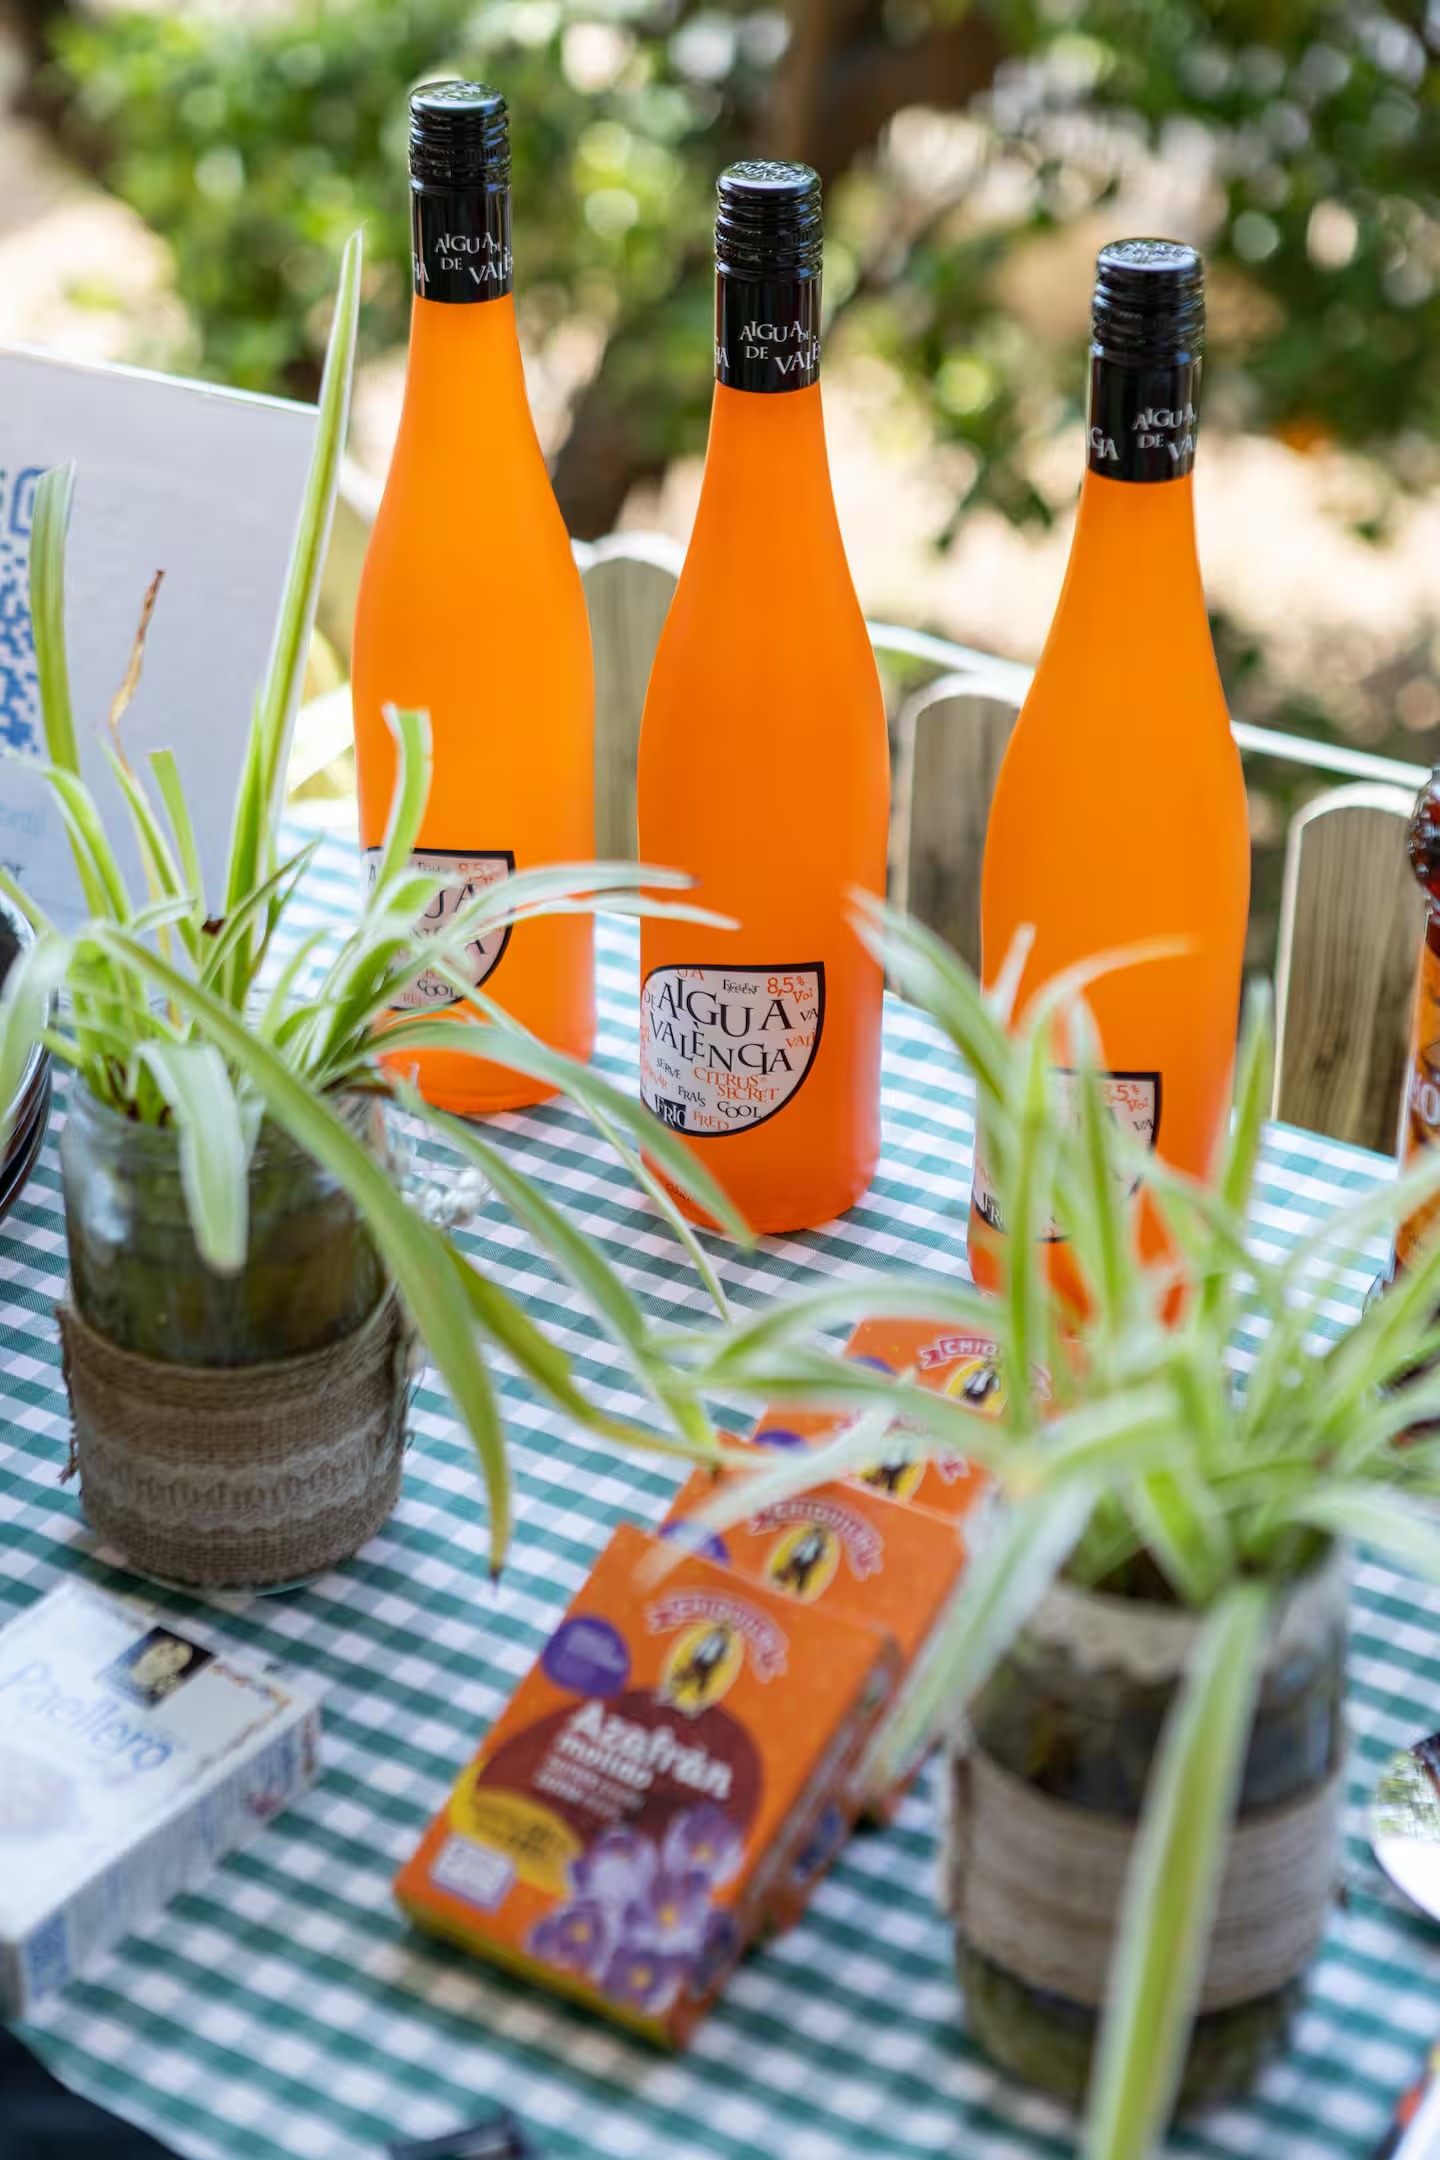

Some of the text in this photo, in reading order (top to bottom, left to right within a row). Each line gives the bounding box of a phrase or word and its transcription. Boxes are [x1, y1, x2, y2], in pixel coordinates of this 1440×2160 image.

[434, 231, 493, 255] AIGUA
[440, 257, 463, 271] DE
[739, 320, 802, 343] AIGUA
[745, 346, 769, 360] DE
[1132, 402, 1194, 431] AIGUA
[1137, 432, 1165, 449] DE
[792, 988, 814, 1004] Vol
[659, 978, 795, 1038] AIGUA
[677, 1086, 762, 1119] FRAIS COOL
[717, 1084, 780, 1103] SECRET
